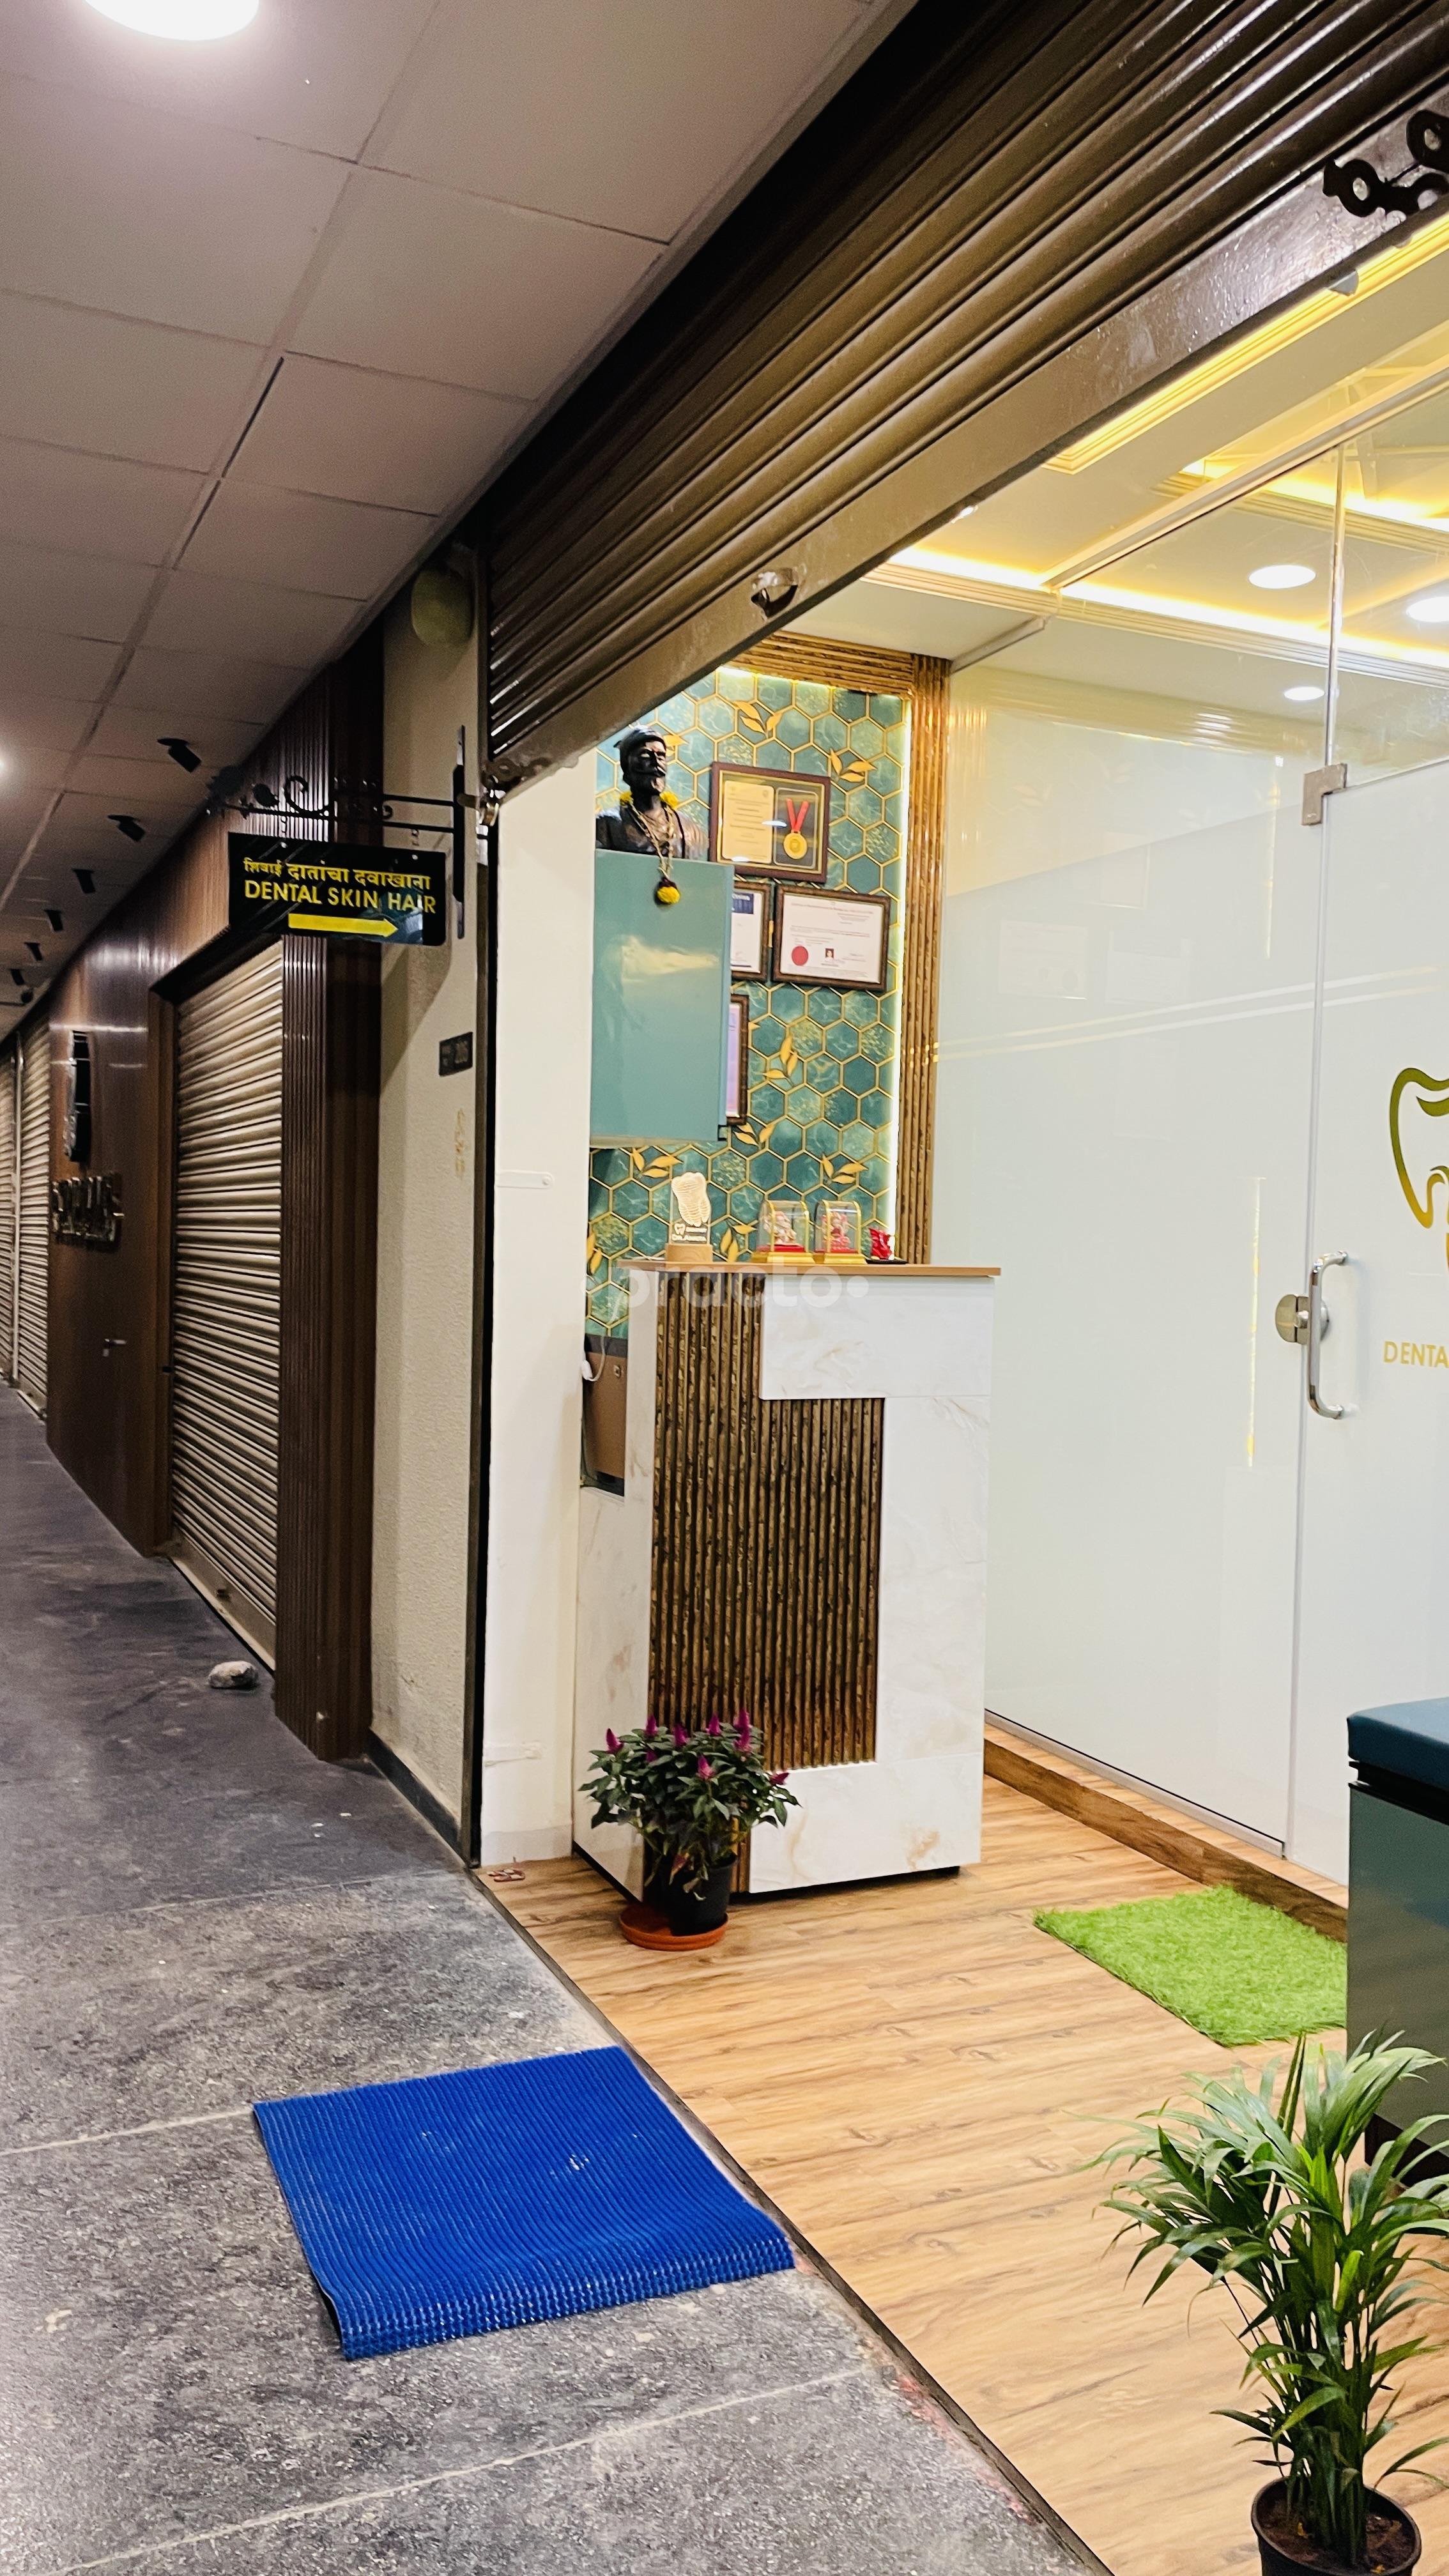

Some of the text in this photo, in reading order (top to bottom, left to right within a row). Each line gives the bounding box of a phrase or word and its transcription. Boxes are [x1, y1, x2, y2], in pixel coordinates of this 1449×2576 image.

[353, 869, 431, 890] दवाखाना
[245, 880, 436, 914] DENTAL SKIN HAIR
[1383, 1340, 1449, 1368] DENTA
